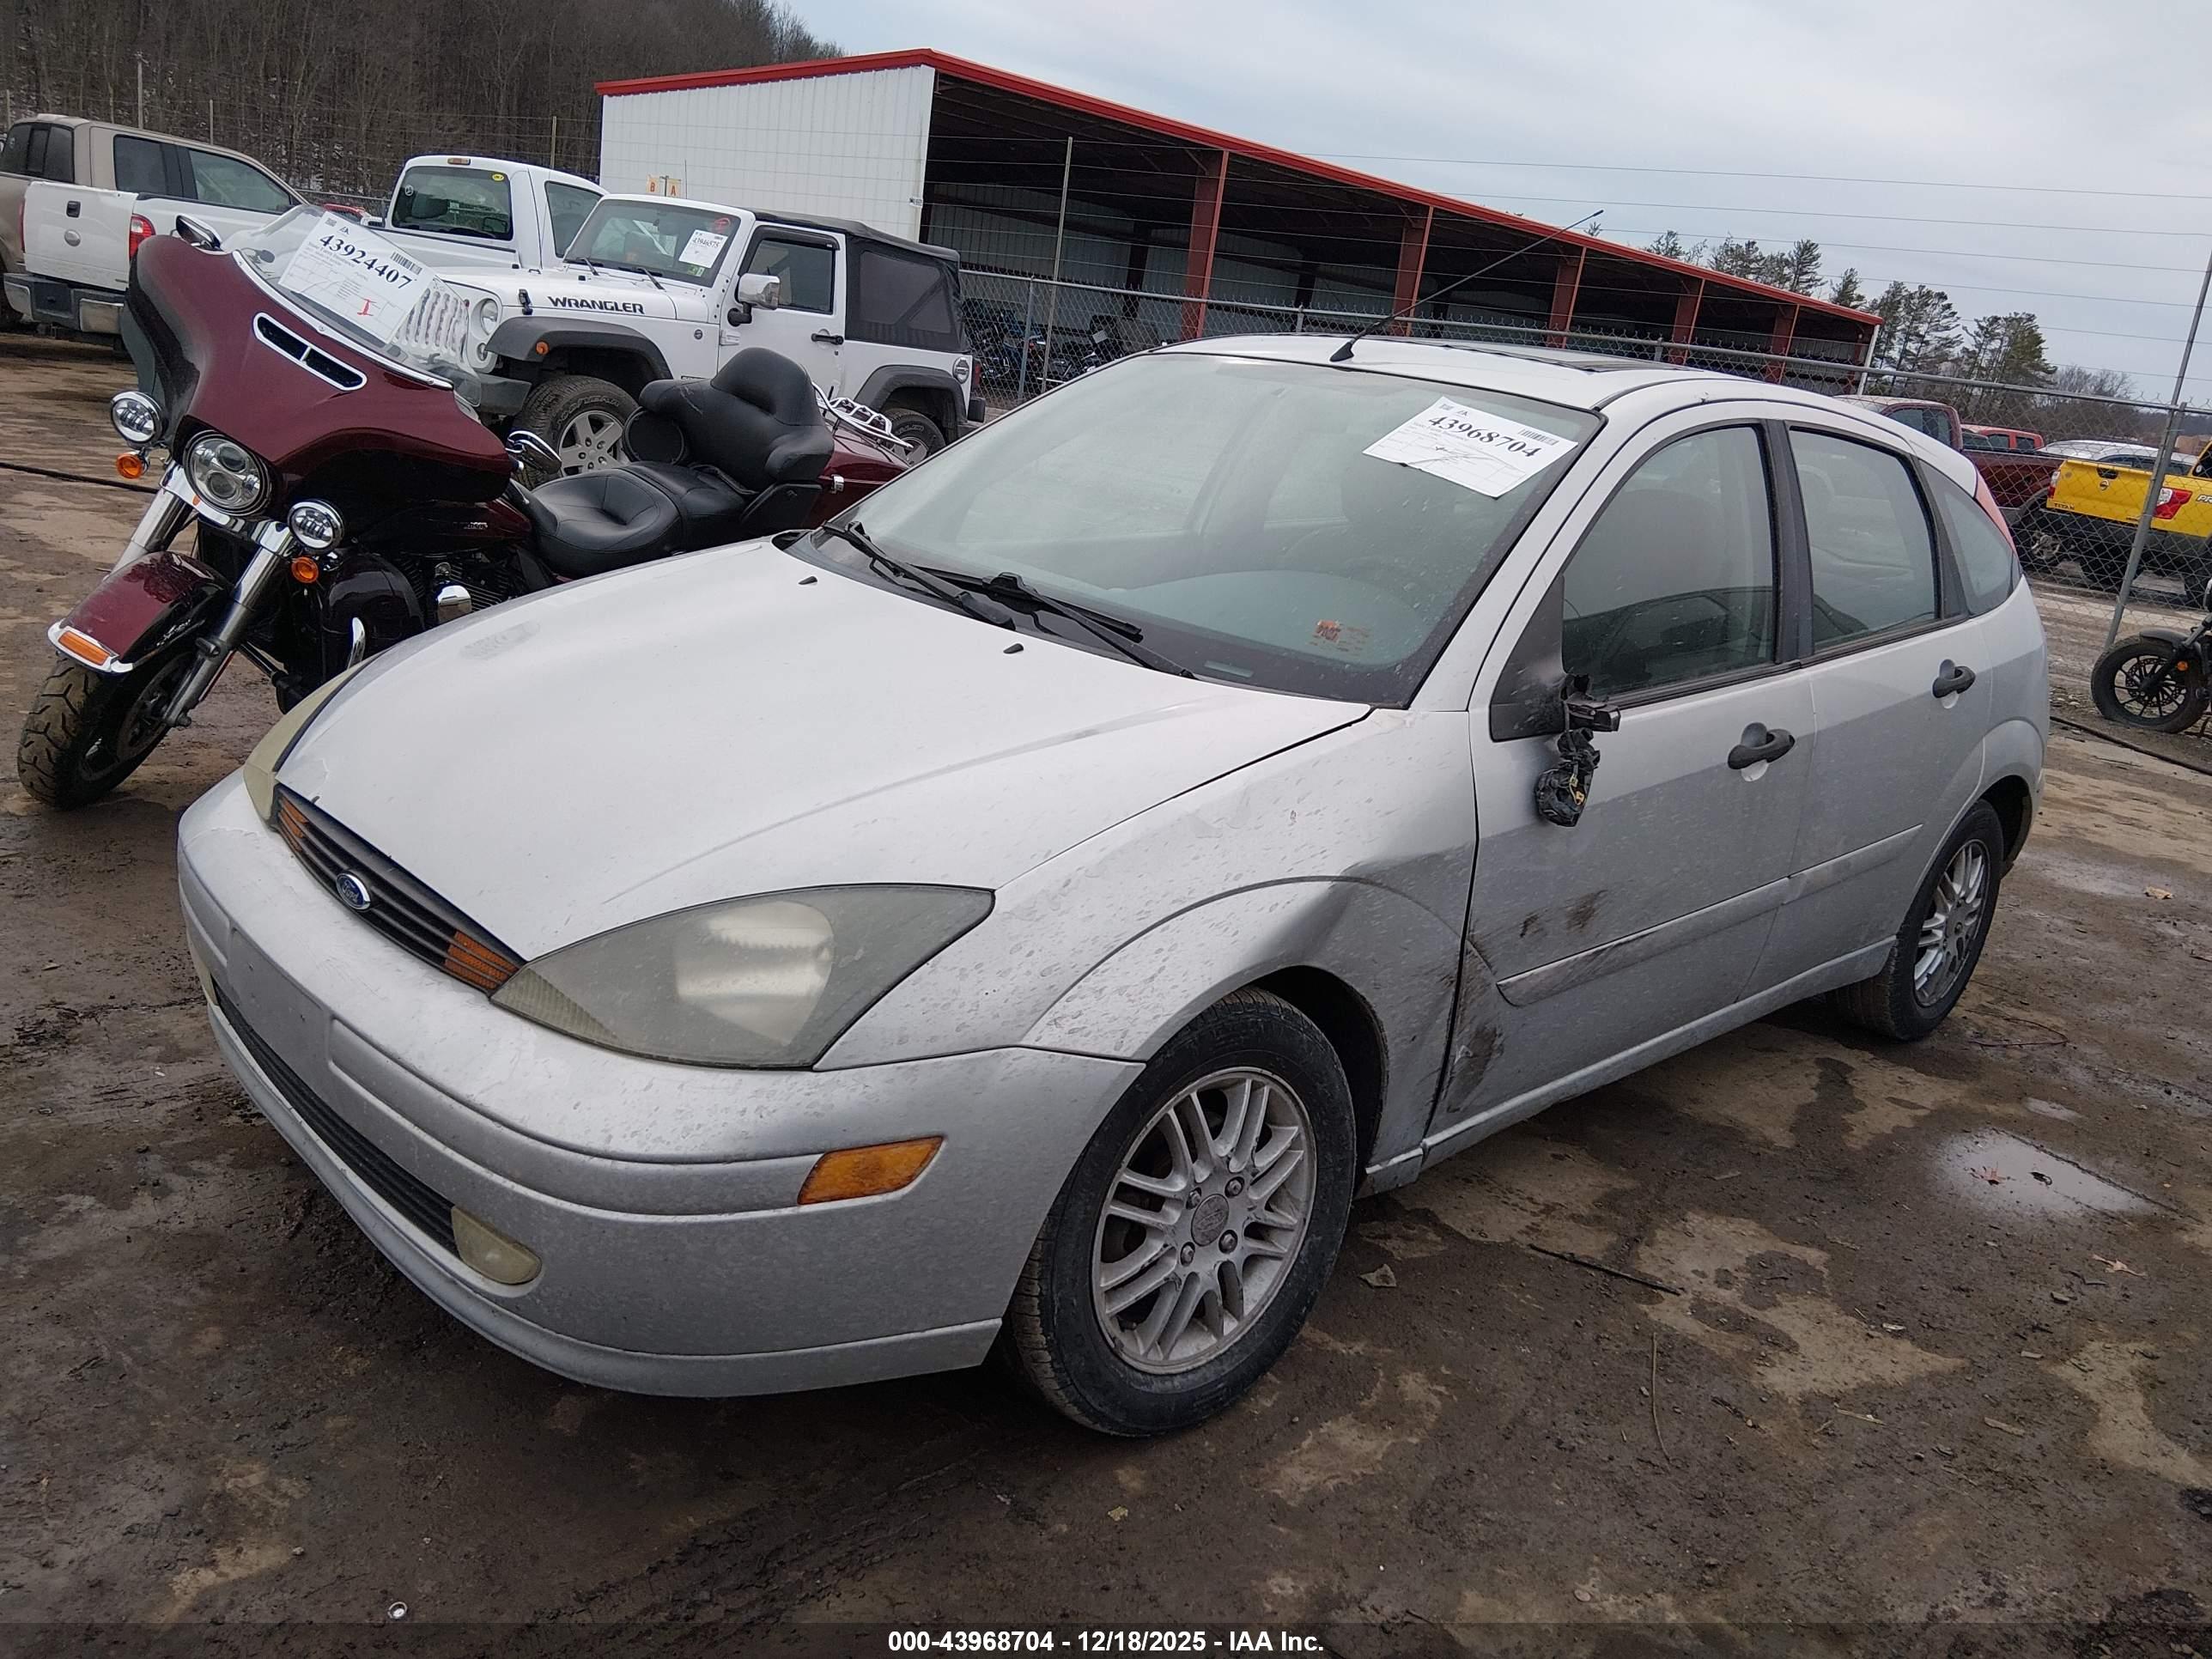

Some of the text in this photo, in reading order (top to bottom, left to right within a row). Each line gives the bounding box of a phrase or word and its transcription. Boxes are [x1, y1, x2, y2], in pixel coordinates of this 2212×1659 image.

[670, 185, 677, 197] A
[319, 234, 412, 289] 43924407
[548, 295, 644, 314] WRANGLER
[1428, 416, 1542, 458] 43968704
[2053, 502, 2075, 511] TITAN
